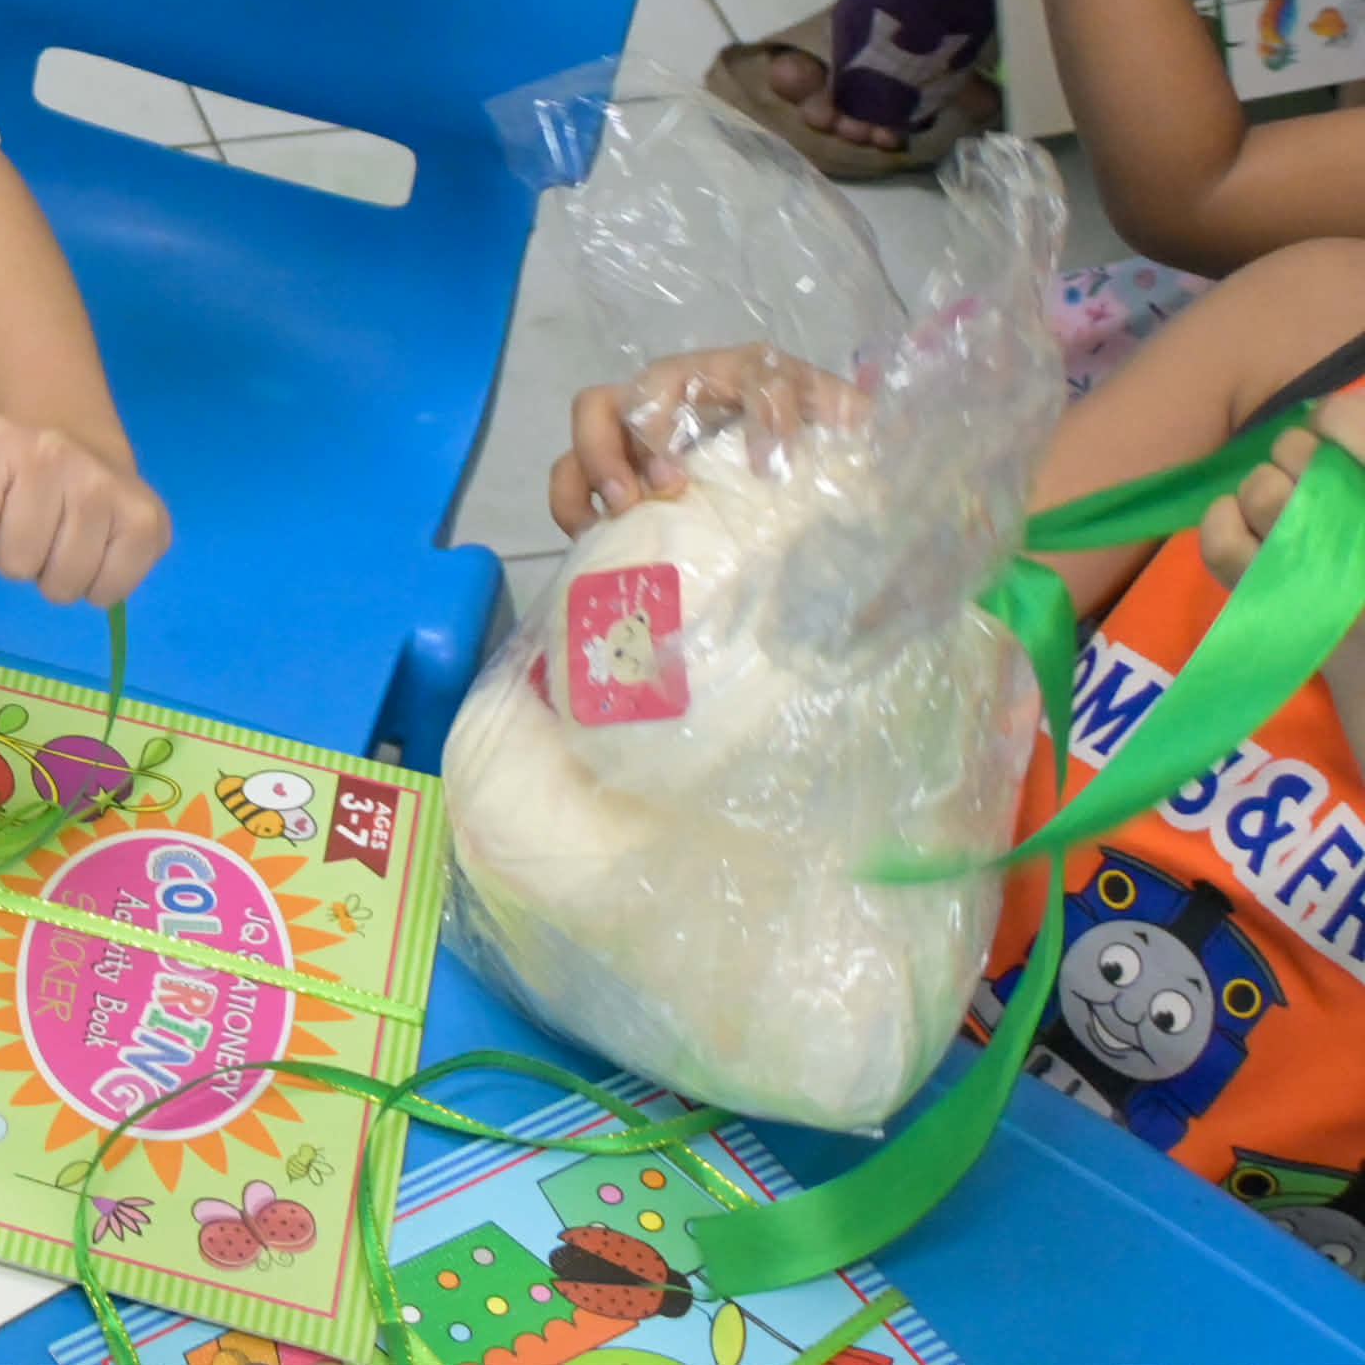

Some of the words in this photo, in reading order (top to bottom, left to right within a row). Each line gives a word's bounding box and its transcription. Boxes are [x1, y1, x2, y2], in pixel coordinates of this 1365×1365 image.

[335, 792, 374, 847] 3-7
[370, 801, 393, 850] AGES
[91, 887, 152, 983] Acvity
[239, 907, 271, 943] JQ
[33, 890, 98, 1022] SICKER
[83, 992, 129, 1047] Book
[212, 949, 267, 1102] SATIONERY
